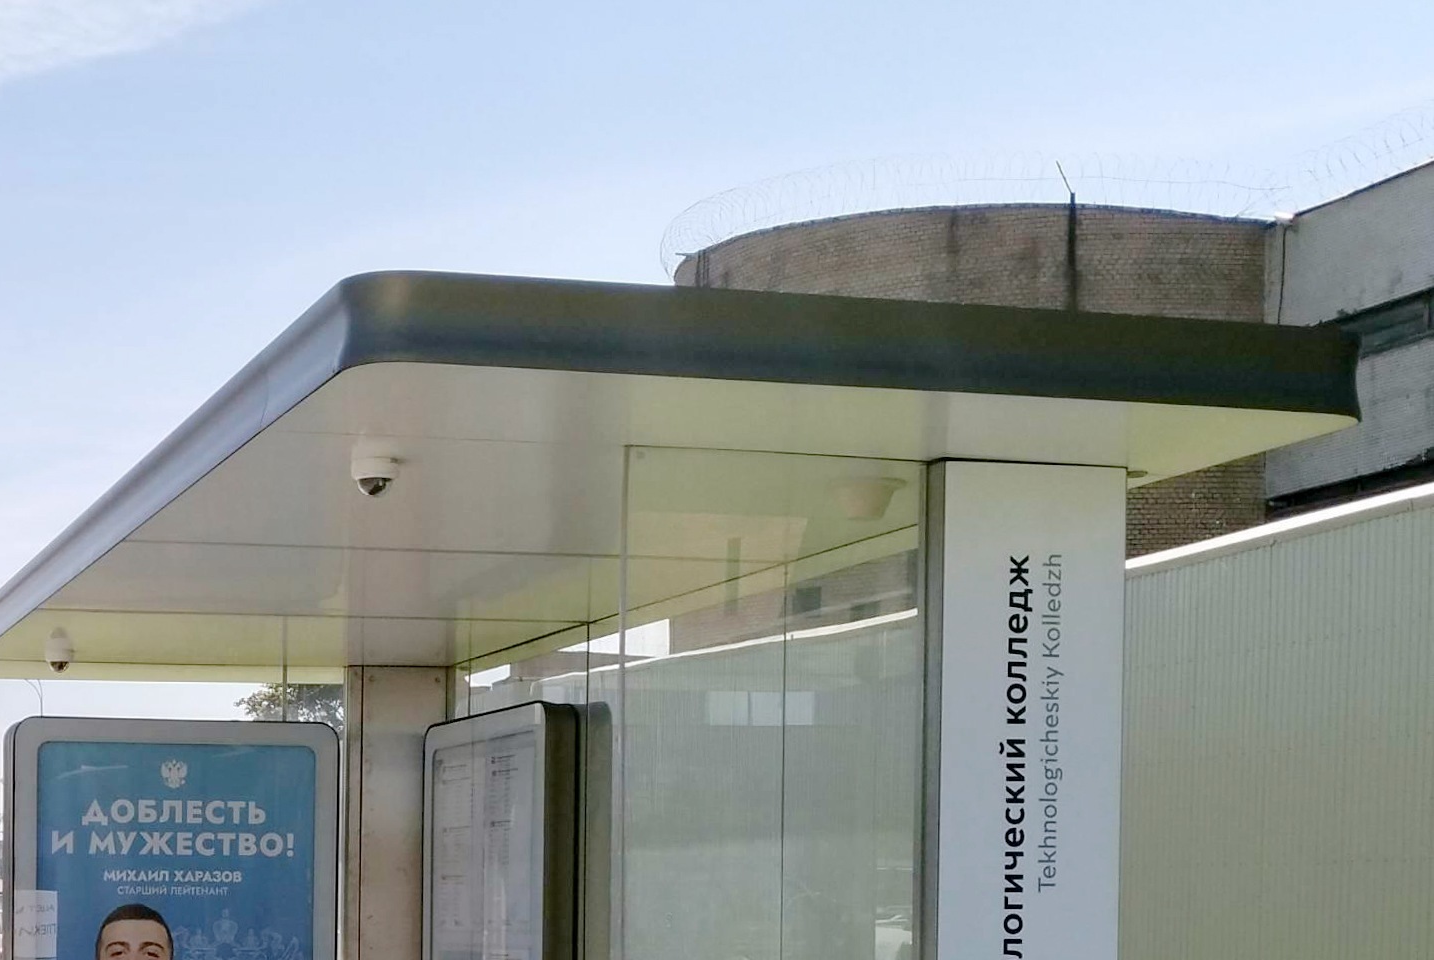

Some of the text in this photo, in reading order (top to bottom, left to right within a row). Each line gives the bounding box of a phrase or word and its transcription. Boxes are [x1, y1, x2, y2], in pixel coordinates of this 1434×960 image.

[1005, 555, 1034, 725] колледж
[1037, 553, 1065, 893] Tekhnologicheskiy Kolledzh
[81, 798, 267, 826] ДОБЛЕСТЬ
[51, 829, 295, 858] И МУЖЕСТВО!
[103, 869, 243, 883] МИХАИЛ ХАРАЗОВ
[116, 885, 229, 896] СТАРШИЙ ЛЕЙТЕНАНТ
